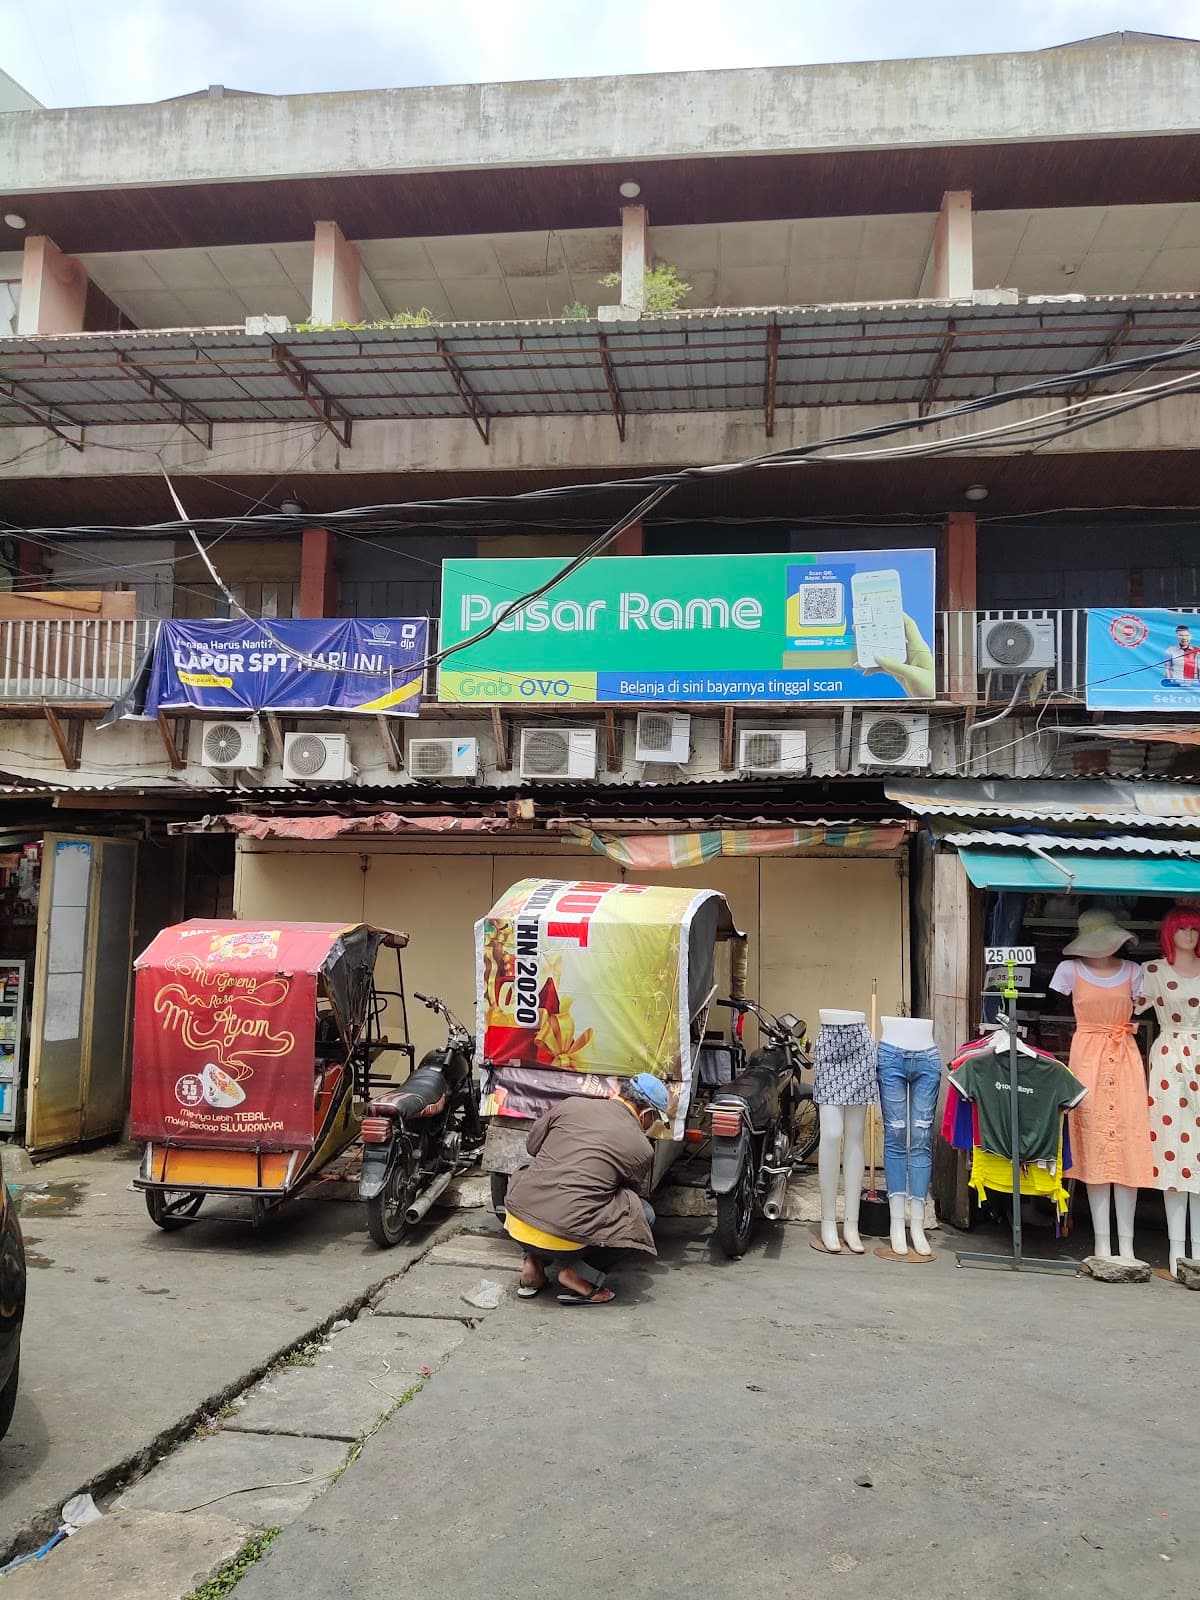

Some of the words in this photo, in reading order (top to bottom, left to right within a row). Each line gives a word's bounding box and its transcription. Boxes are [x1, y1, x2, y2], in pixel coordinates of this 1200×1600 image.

[461, 593, 607, 632] Pasar
[619, 592, 763, 631] Rame
[210, 640, 241, 650] Harus
[242, 640, 273, 649] Nanti?
[400, 639, 415, 650] djp
[174, 650, 245, 673] LAPOR
[248, 653, 291, 673] SPT
[298, 651, 347, 672] HARI
[459, 678, 513, 697] Grab
[520, 679, 570, 696] OVO
[620, 680, 665, 696] Belanja
[668, 680, 680, 693] di
[683, 680, 703, 693] sini
[707, 680, 765, 696] bayarnya
[768, 679, 810, 695] tinggal
[813, 681, 843, 692] scan
[516, 914, 540, 956] THN
[516, 962, 538, 1024] 2020
[213, 1005, 269, 1047] Ayam
